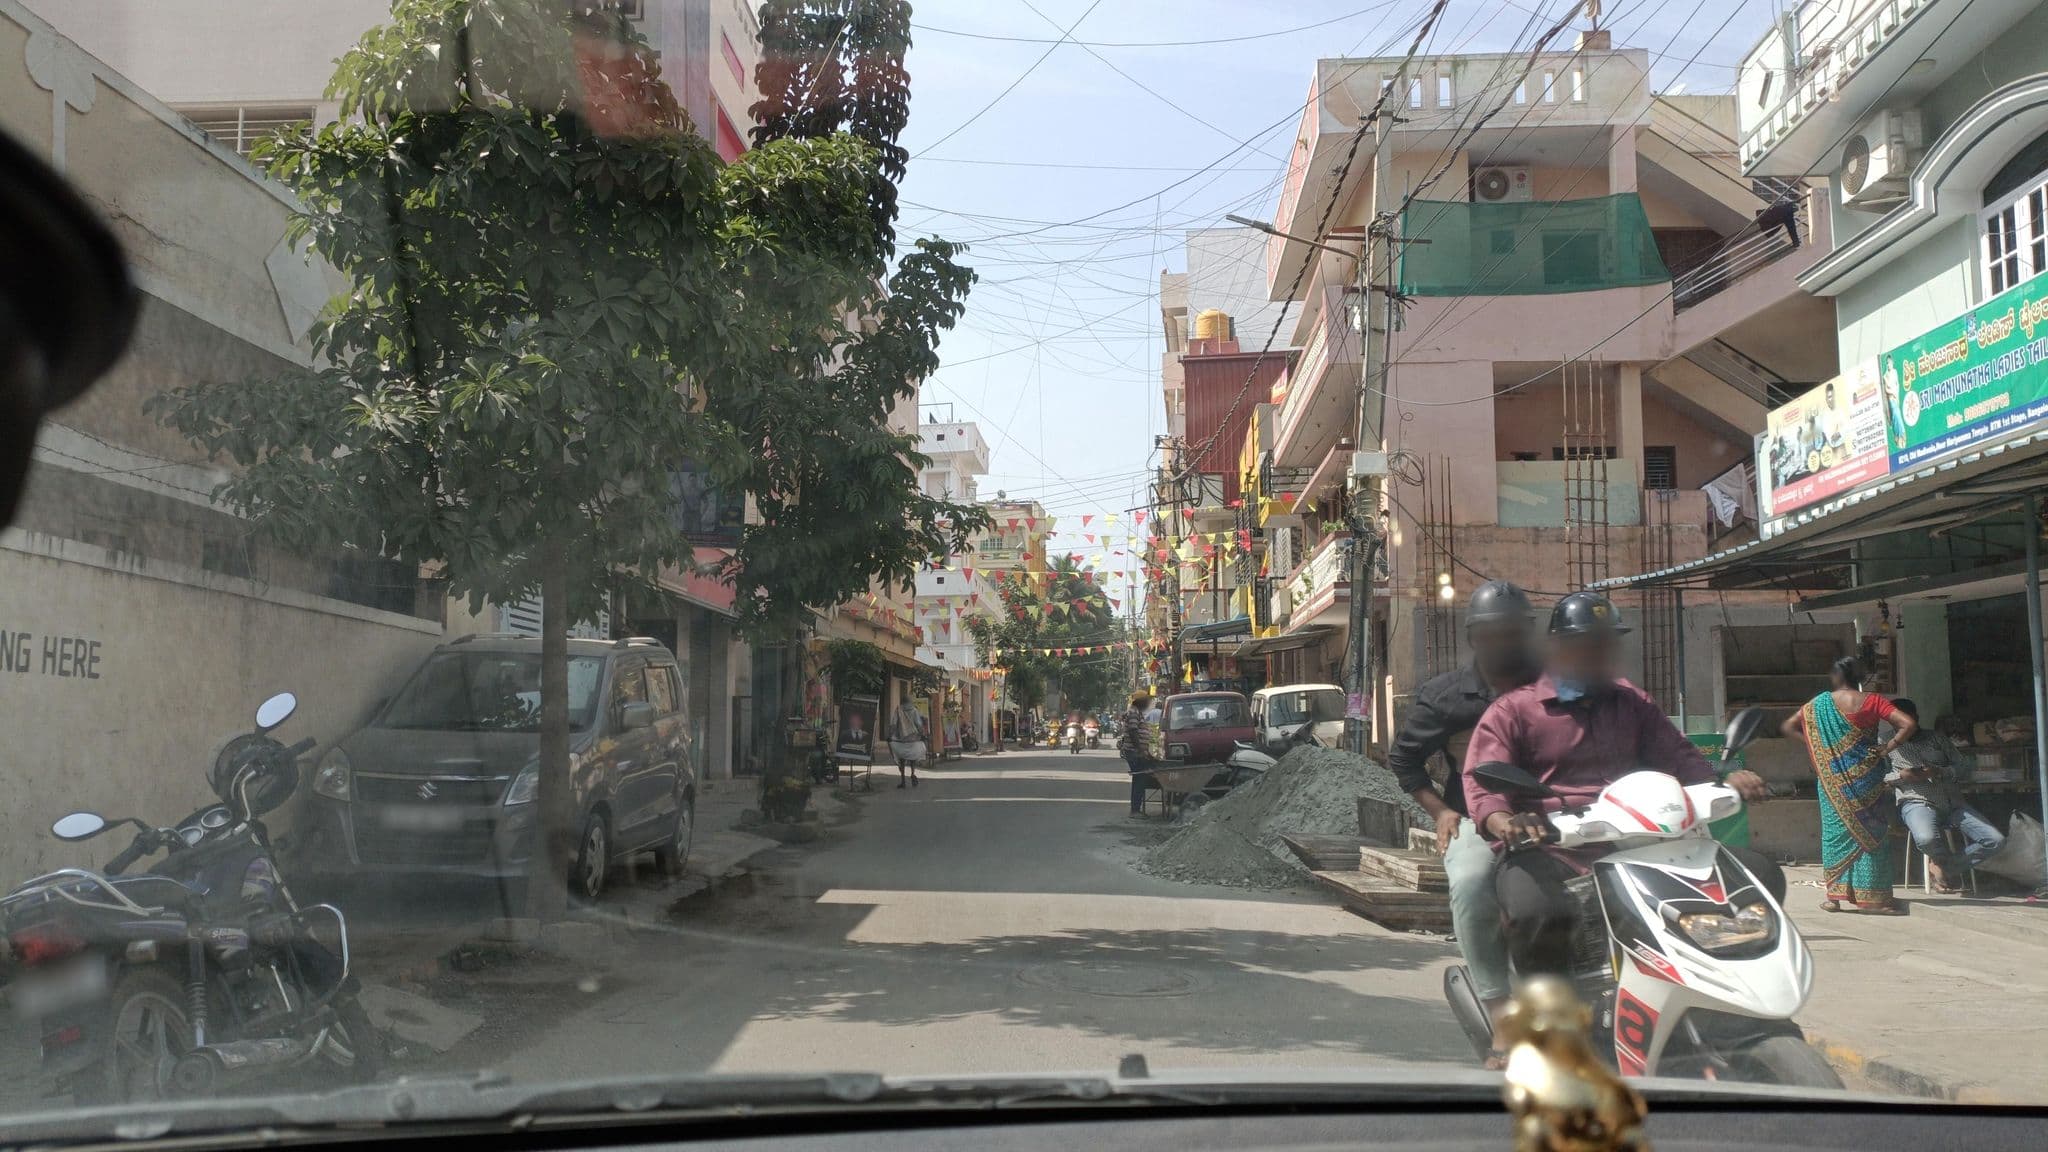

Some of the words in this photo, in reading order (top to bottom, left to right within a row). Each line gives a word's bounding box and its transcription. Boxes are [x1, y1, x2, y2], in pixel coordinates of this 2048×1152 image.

[1919, 387, 1933, 410] SRI
[1933, 361, 1991, 404] MANJUNATHA
[1991, 346, 2026, 380] LADIES
[0, 630, 31, 672] NG
[42, 636, 102, 679] HERE
